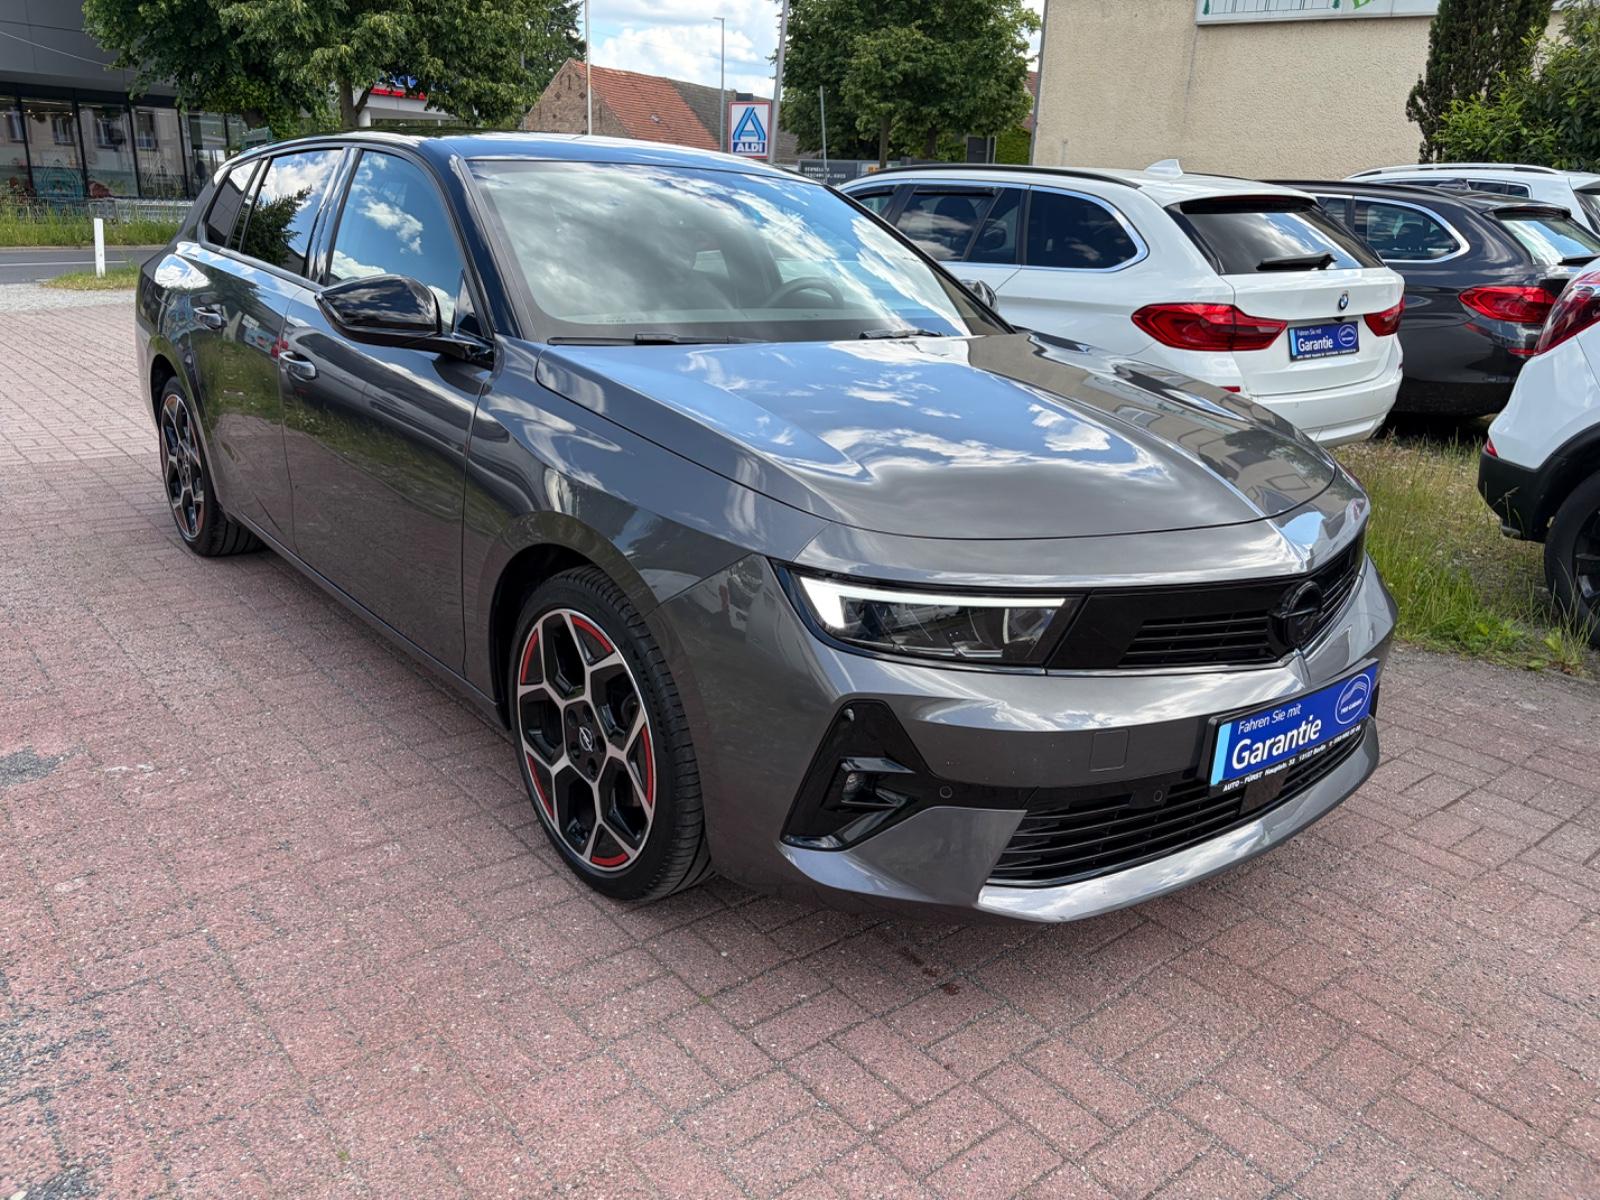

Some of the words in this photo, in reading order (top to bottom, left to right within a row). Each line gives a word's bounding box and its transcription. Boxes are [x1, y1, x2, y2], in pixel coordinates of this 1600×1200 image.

[735, 141, 763, 153] ALDI
[1297, 336, 1333, 352] Garantie
[1238, 716, 1270, 735] Fahren
[1271, 710, 1286, 722] Sie
[1286, 703, 1302, 718] mit
[1232, 714, 1322, 770] Garantie
[1223, 779, 1240, 792] AUTO
